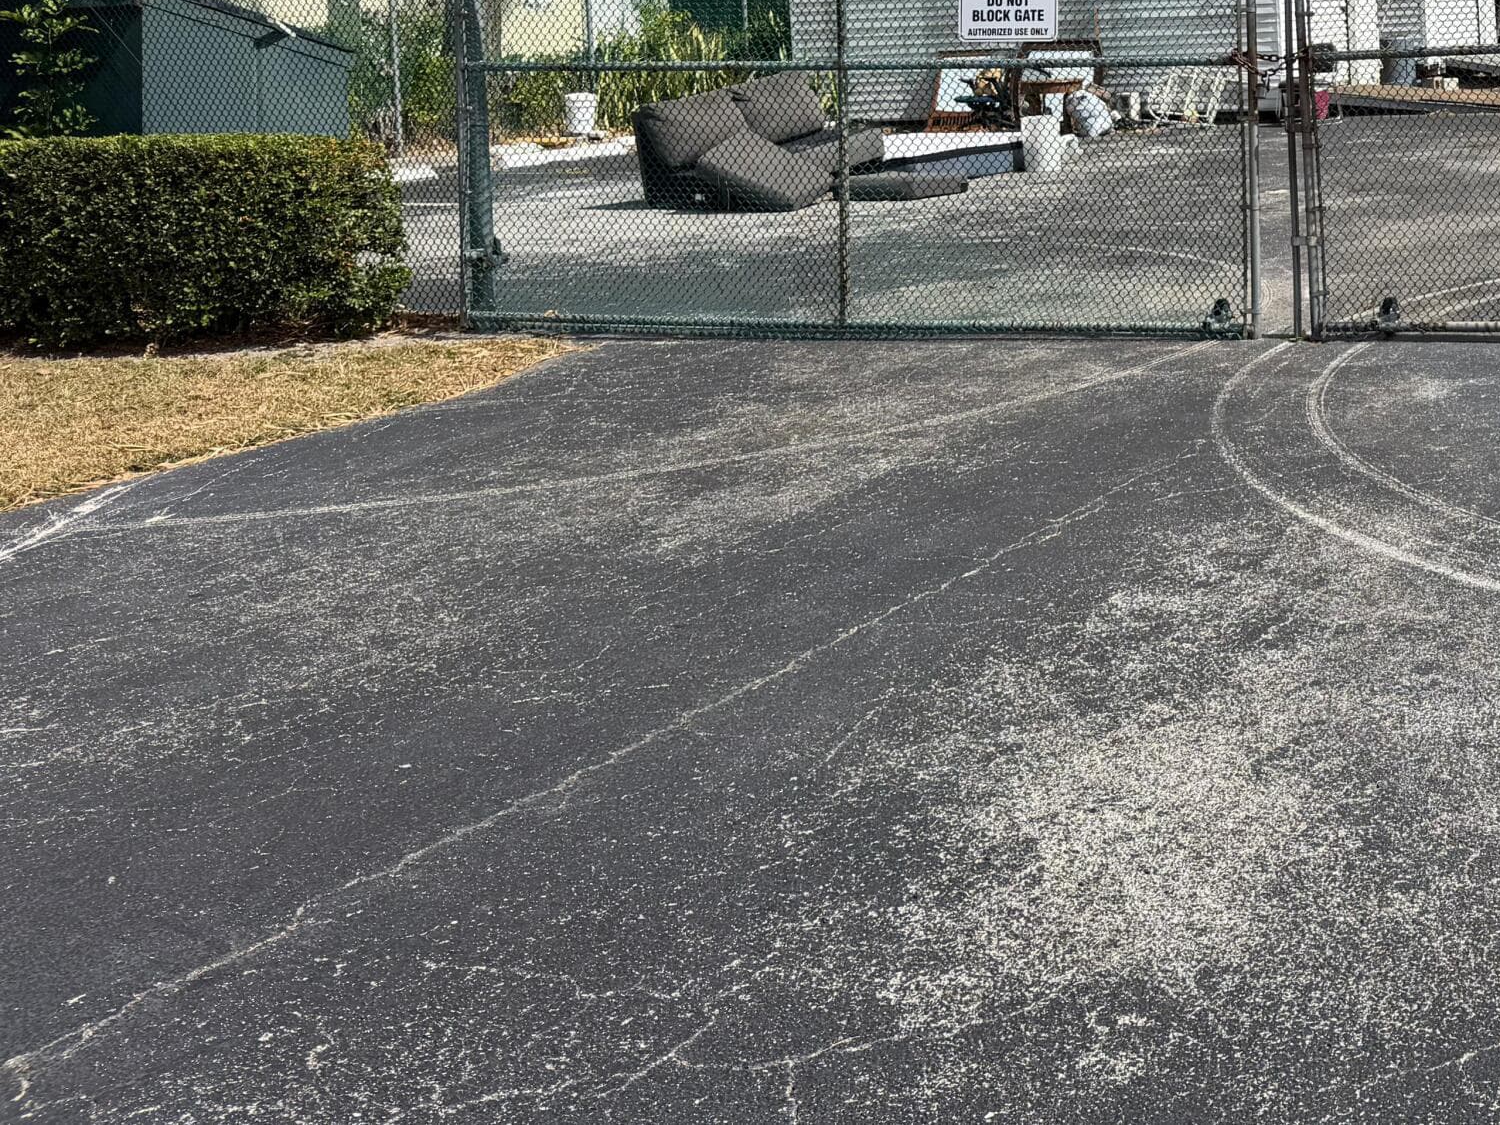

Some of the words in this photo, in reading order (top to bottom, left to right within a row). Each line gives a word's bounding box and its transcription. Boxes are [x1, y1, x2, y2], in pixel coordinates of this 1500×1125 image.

[972, 9, 1010, 22] BLOCK
[1014, 9, 1044, 22] GATE
[968, 28, 1012, 36] AUTHORIZED
[1015, 28, 1028, 36] USE
[1030, 28, 1048, 36] ONLY
